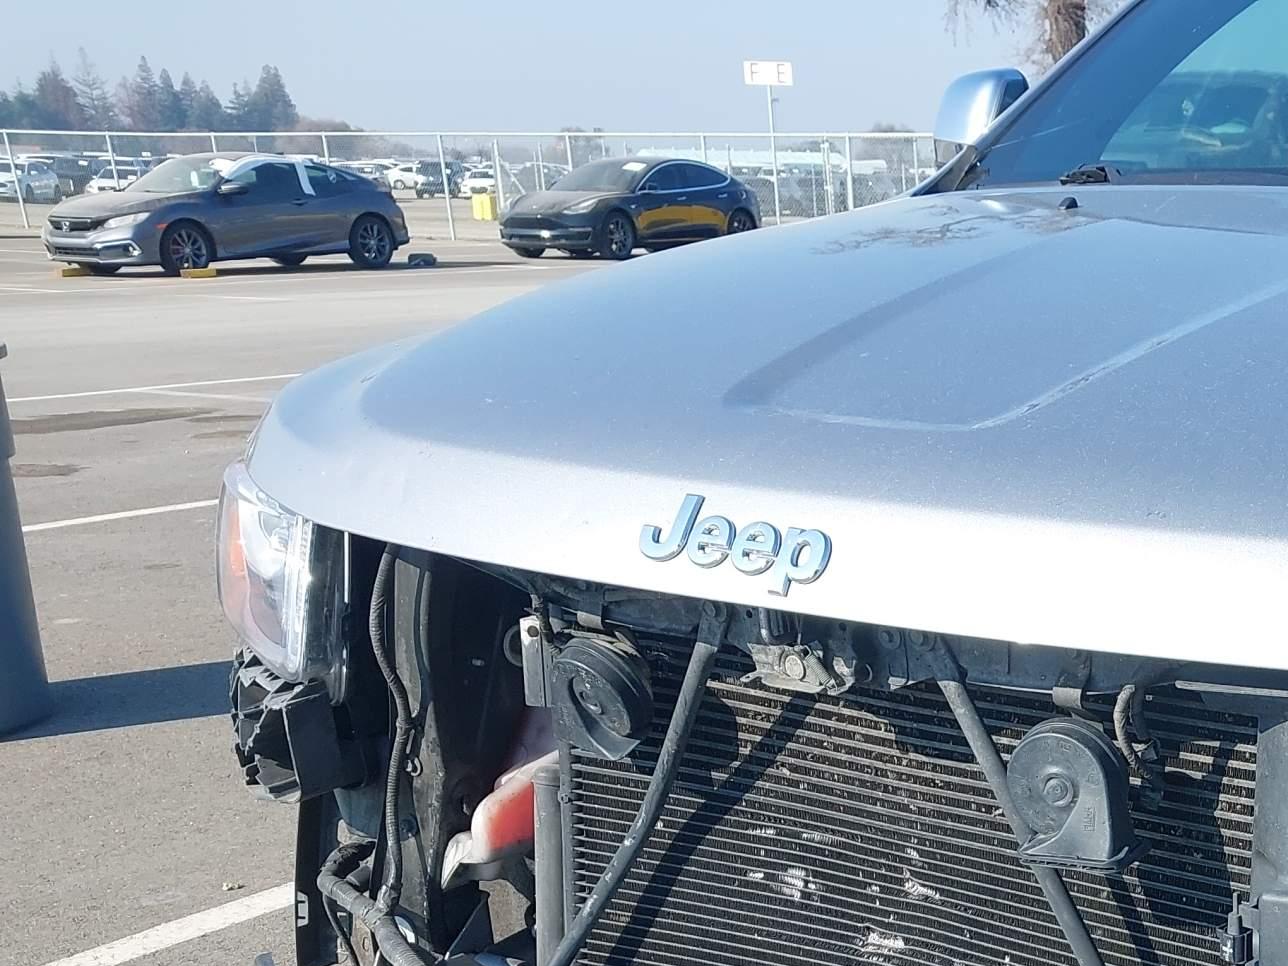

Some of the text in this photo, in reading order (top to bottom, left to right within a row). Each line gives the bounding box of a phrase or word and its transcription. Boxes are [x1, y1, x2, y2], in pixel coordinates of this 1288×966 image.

[750, 62, 786, 83] F E
[639, 493, 832, 598] Jeep
